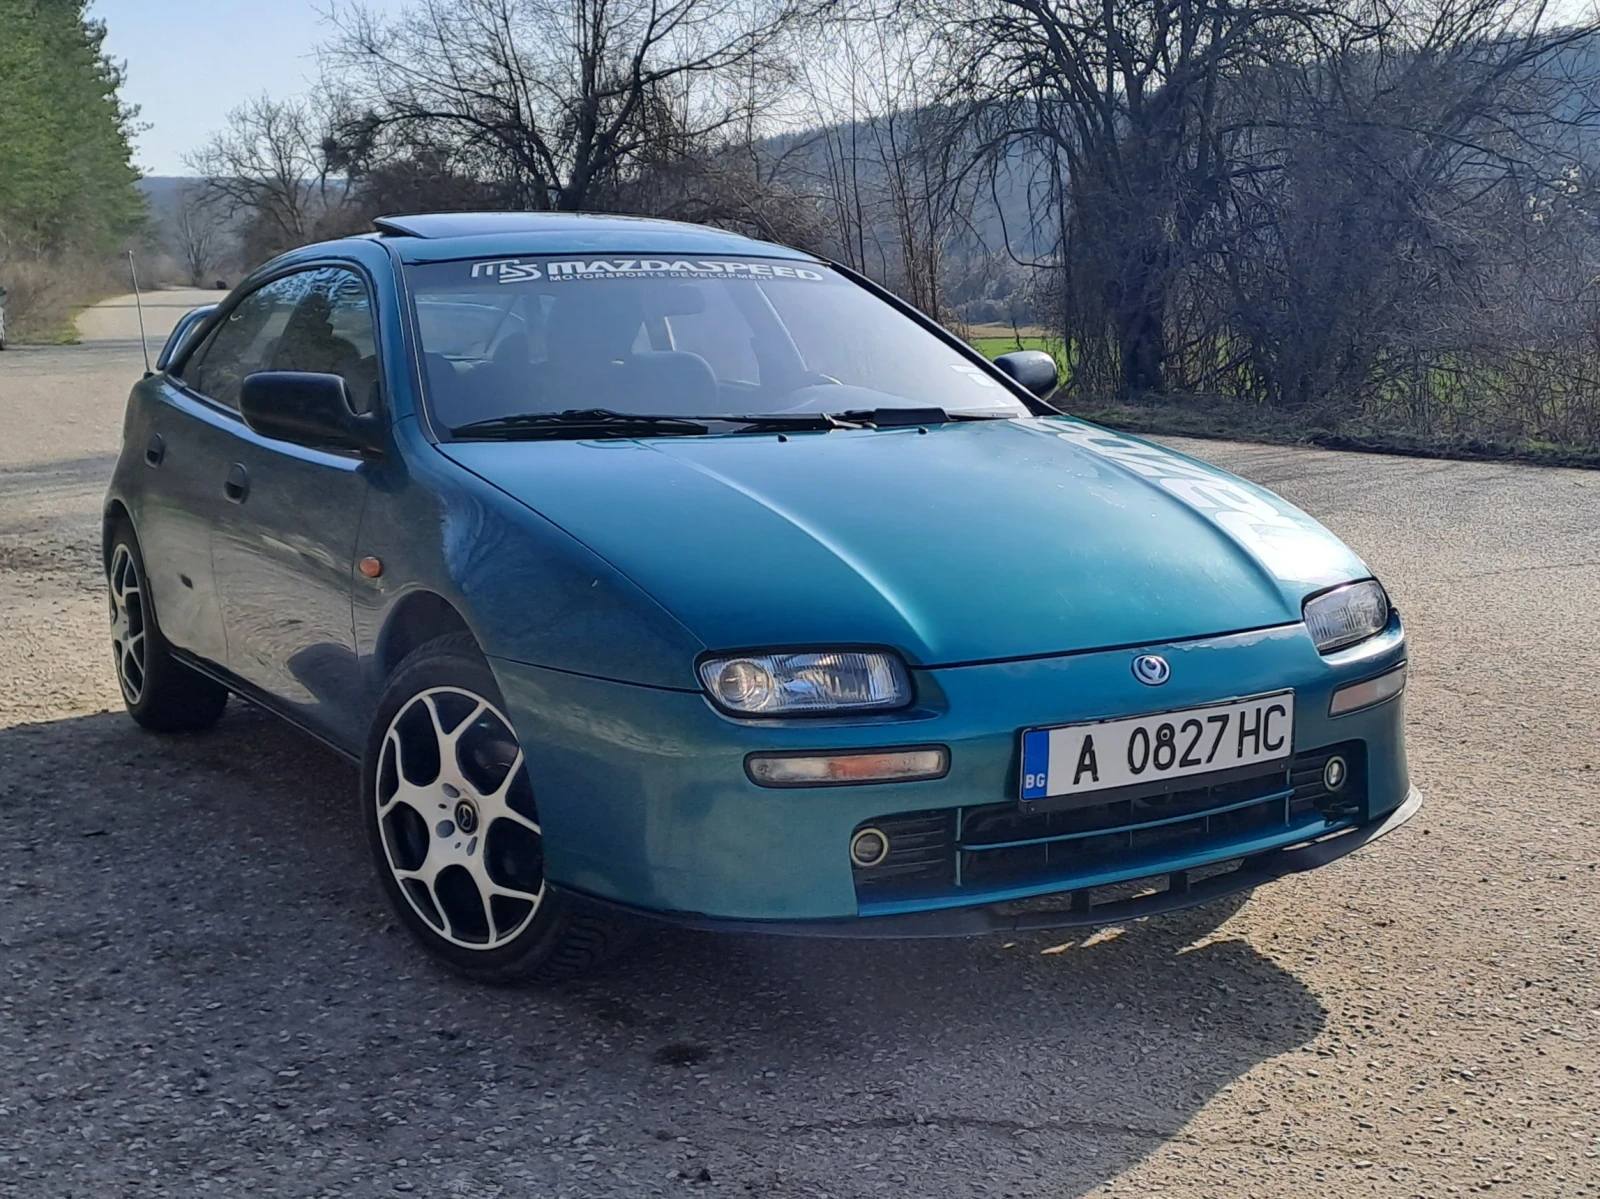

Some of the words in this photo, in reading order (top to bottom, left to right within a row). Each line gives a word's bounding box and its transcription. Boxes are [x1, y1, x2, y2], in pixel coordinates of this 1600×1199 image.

[547, 259, 824, 282] MAZDASPEED
[549, 271, 665, 282] MOTORSPORTS
[669, 271, 774, 281] DEVELOPMENT
[1025, 773, 1046, 789] BG
[1072, 734, 1100, 786] A
[1127, 714, 1230, 775] 0827
[1236, 704, 1286, 758] HC
